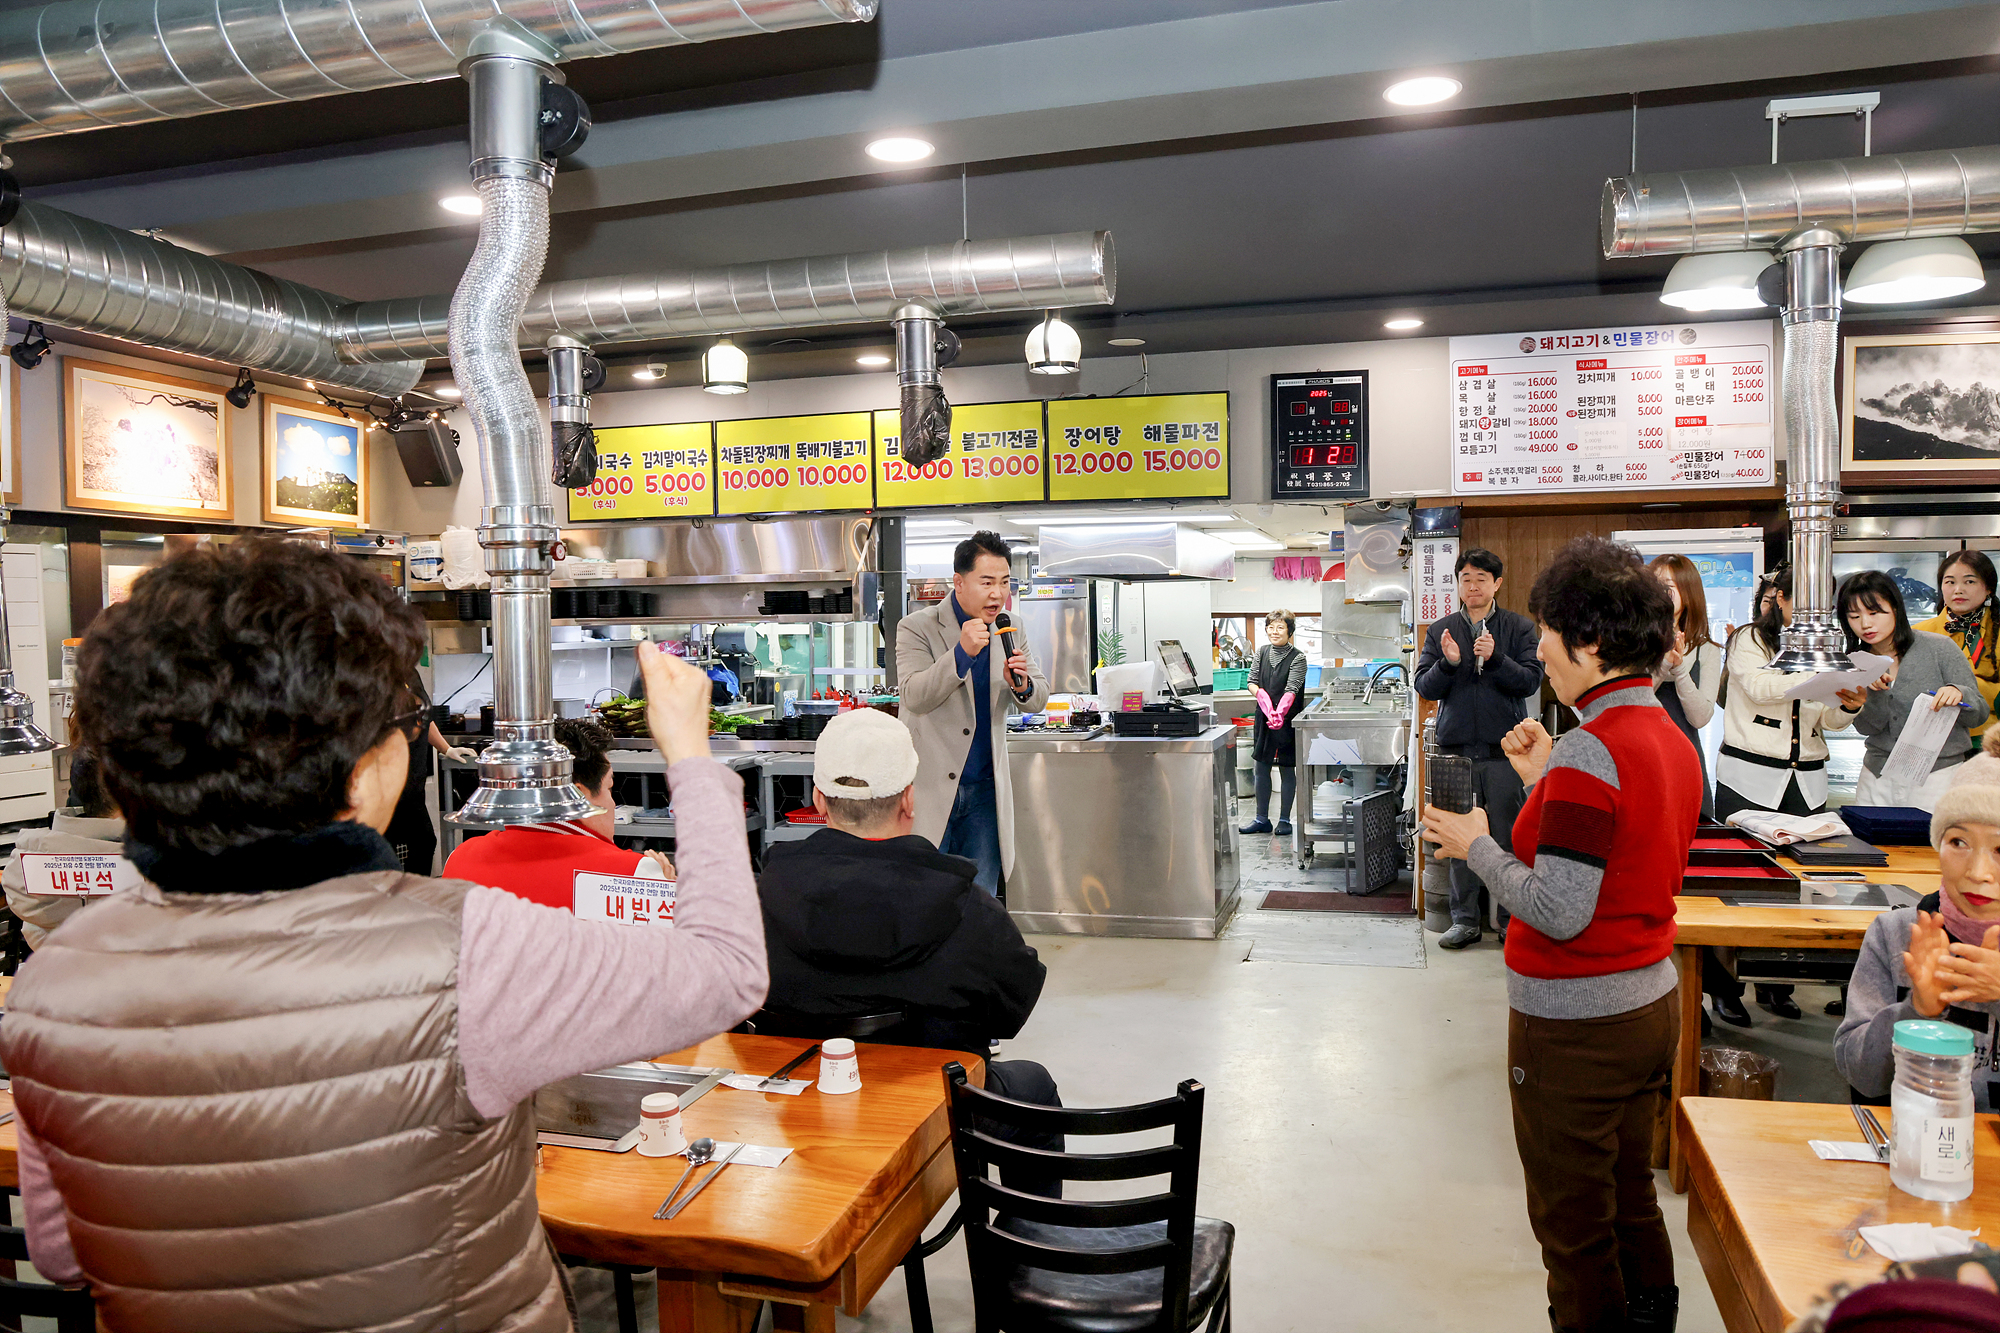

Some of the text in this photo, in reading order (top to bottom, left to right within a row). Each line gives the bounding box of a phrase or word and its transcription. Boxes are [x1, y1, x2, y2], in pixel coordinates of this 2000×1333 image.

[1540, 329, 1675, 350] 돼지고기 & 민물장어
[1578, 361, 1604, 369] 식사메뉴
[1676, 356, 1703, 364] 안주메뉴
[1460, 367, 1485, 375] 고기메뉴
[1732, 365, 1764, 376] 20.000
[1528, 376, 1557, 387] 16.000
[1577, 370, 1662, 384] 김치찌개 10.000
[1732, 378, 1764, 389] 15.000
[1310, 390, 1328, 398] 2025
[1528, 390, 1558, 400] 16.000
[1577, 393, 1662, 407] 된장찌개 8.000
[1675, 392, 1764, 406] 마른안주 15.000
[1528, 403, 1558, 413] 20.000
[1577, 407, 1616, 419] 된장찌개
[1637, 406, 1663, 416] 5.000
[1528, 416, 1558, 427] 18.000
[1677, 418, 1704, 426] 장어메뉴
[1064, 426, 1121, 448] 장어탕
[1143, 422, 1219, 444] 해물파전
[1528, 430, 1558, 440] 10.000
[961, 428, 1038, 451] 불고기전골
[1638, 439, 1664, 450] 5.000
[721, 443, 790, 464] 차돌된장찌개
[796, 440, 867, 461] 뚝배기불고기
[1528, 443, 1558, 454] 49.000
[596, 453, 632, 471] 국수
[642, 449, 708, 469] 김치말이국수
[1143, 448, 1221, 473] 15,000
[1684, 450, 1724, 462] 민물장어
[961, 454, 1039, 478] 13,000
[1053, 451, 1133, 475] 12,000
[1625, 463, 1648, 471] 6.000
[797, 463, 867, 487] 10,000
[883, 458, 953, 482] 12,000
[1541, 465, 1563, 474] 5.000
[1684, 469, 1720, 480] 민물장어
[1736, 468, 1764, 477] 40.000
[722, 466, 790, 491] 10,000
[1537, 475, 1563, 484] 16.000
[1626, 472, 1648, 481] 2.000
[645, 472, 706, 494] 5,000
[593, 500, 616, 509] (후식)
[664, 497, 688, 506] (후식)
[1423, 543, 1435, 587] 해물파전
[599, 884, 620, 893] 2025년
[621, 886, 633, 894] 자유
[1938, 1126, 1955, 1158] 새로
